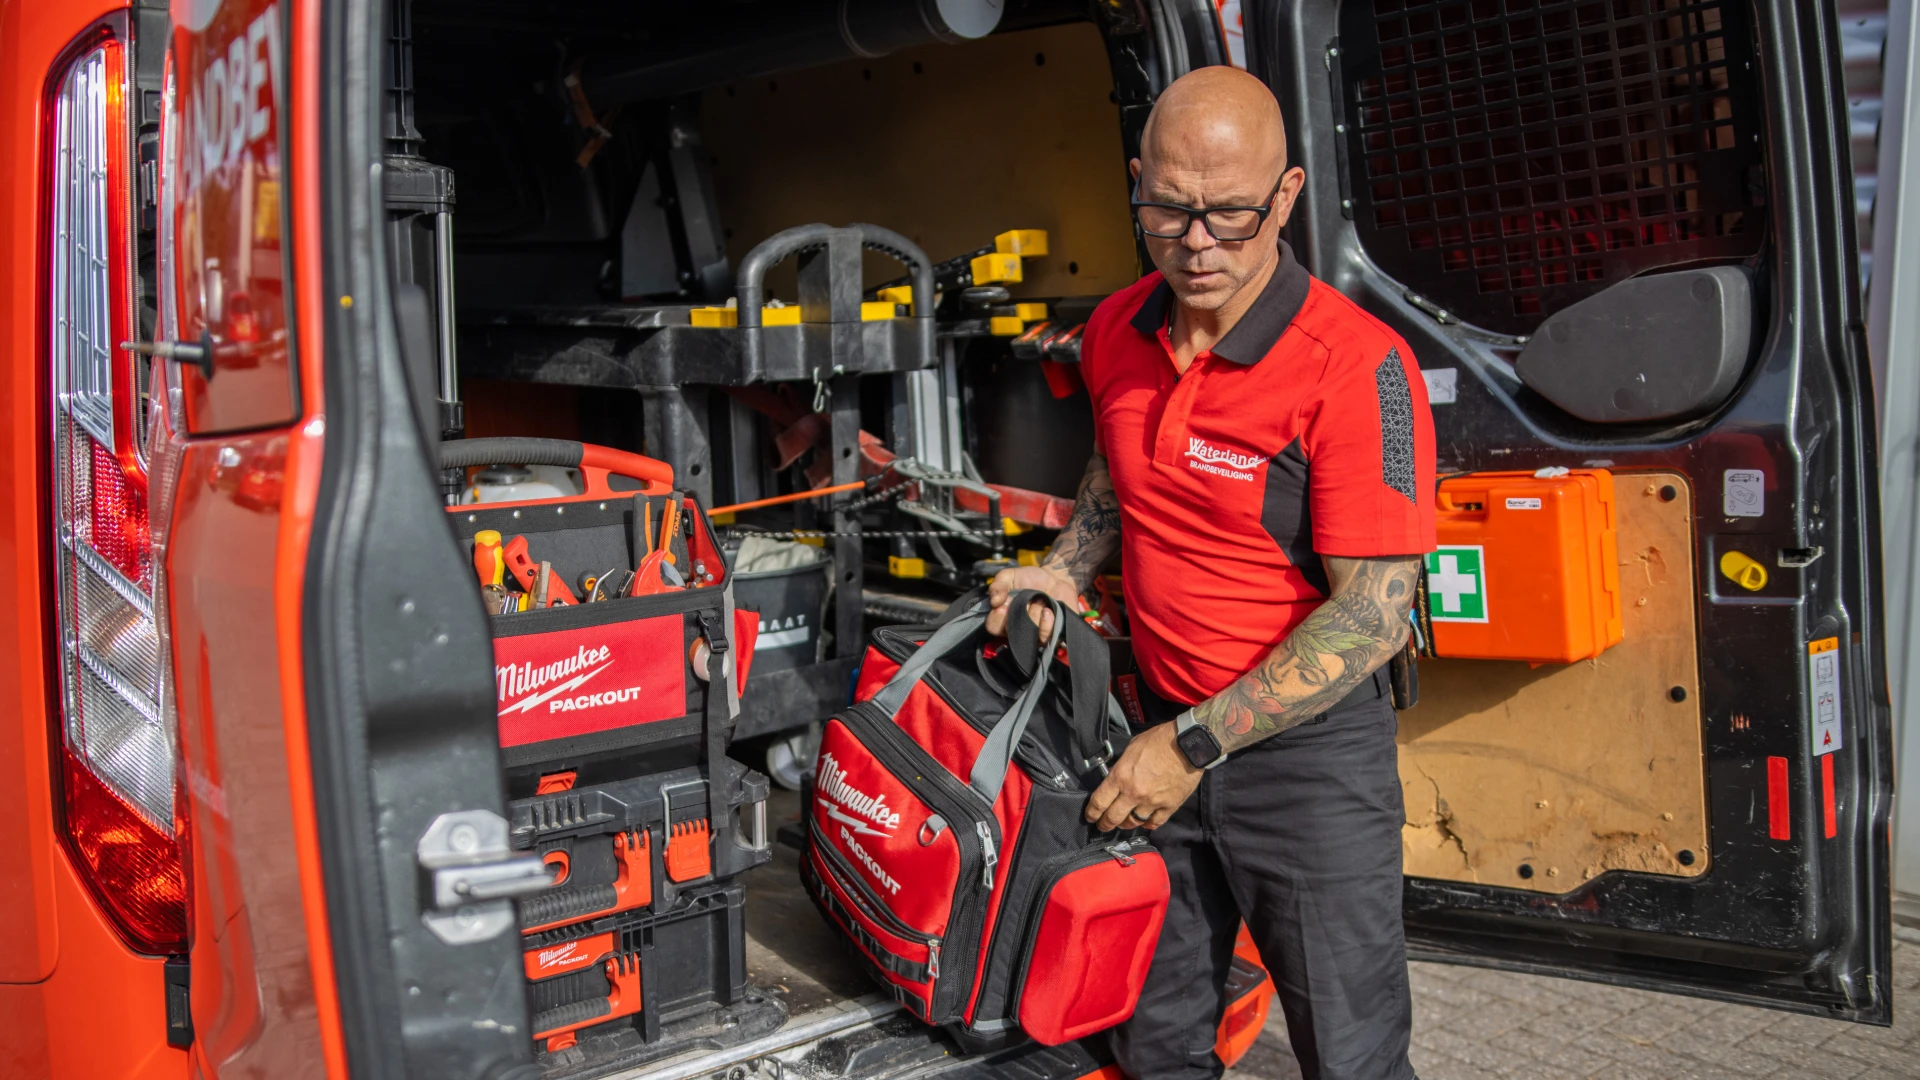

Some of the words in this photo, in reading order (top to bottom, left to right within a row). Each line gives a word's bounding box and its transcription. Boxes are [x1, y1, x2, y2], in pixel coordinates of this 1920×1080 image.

[1189, 436, 1260, 468] Waterland
[1189, 459, 1254, 482] BRANDBEVEILIGING
[495, 644, 611, 702] Milwaukee
[549, 686, 641, 714] PACKOUT
[817, 751, 900, 829] Milwaukee
[840, 825, 901, 895] PACKOUT
[558, 954, 588, 966] PACKOUT
